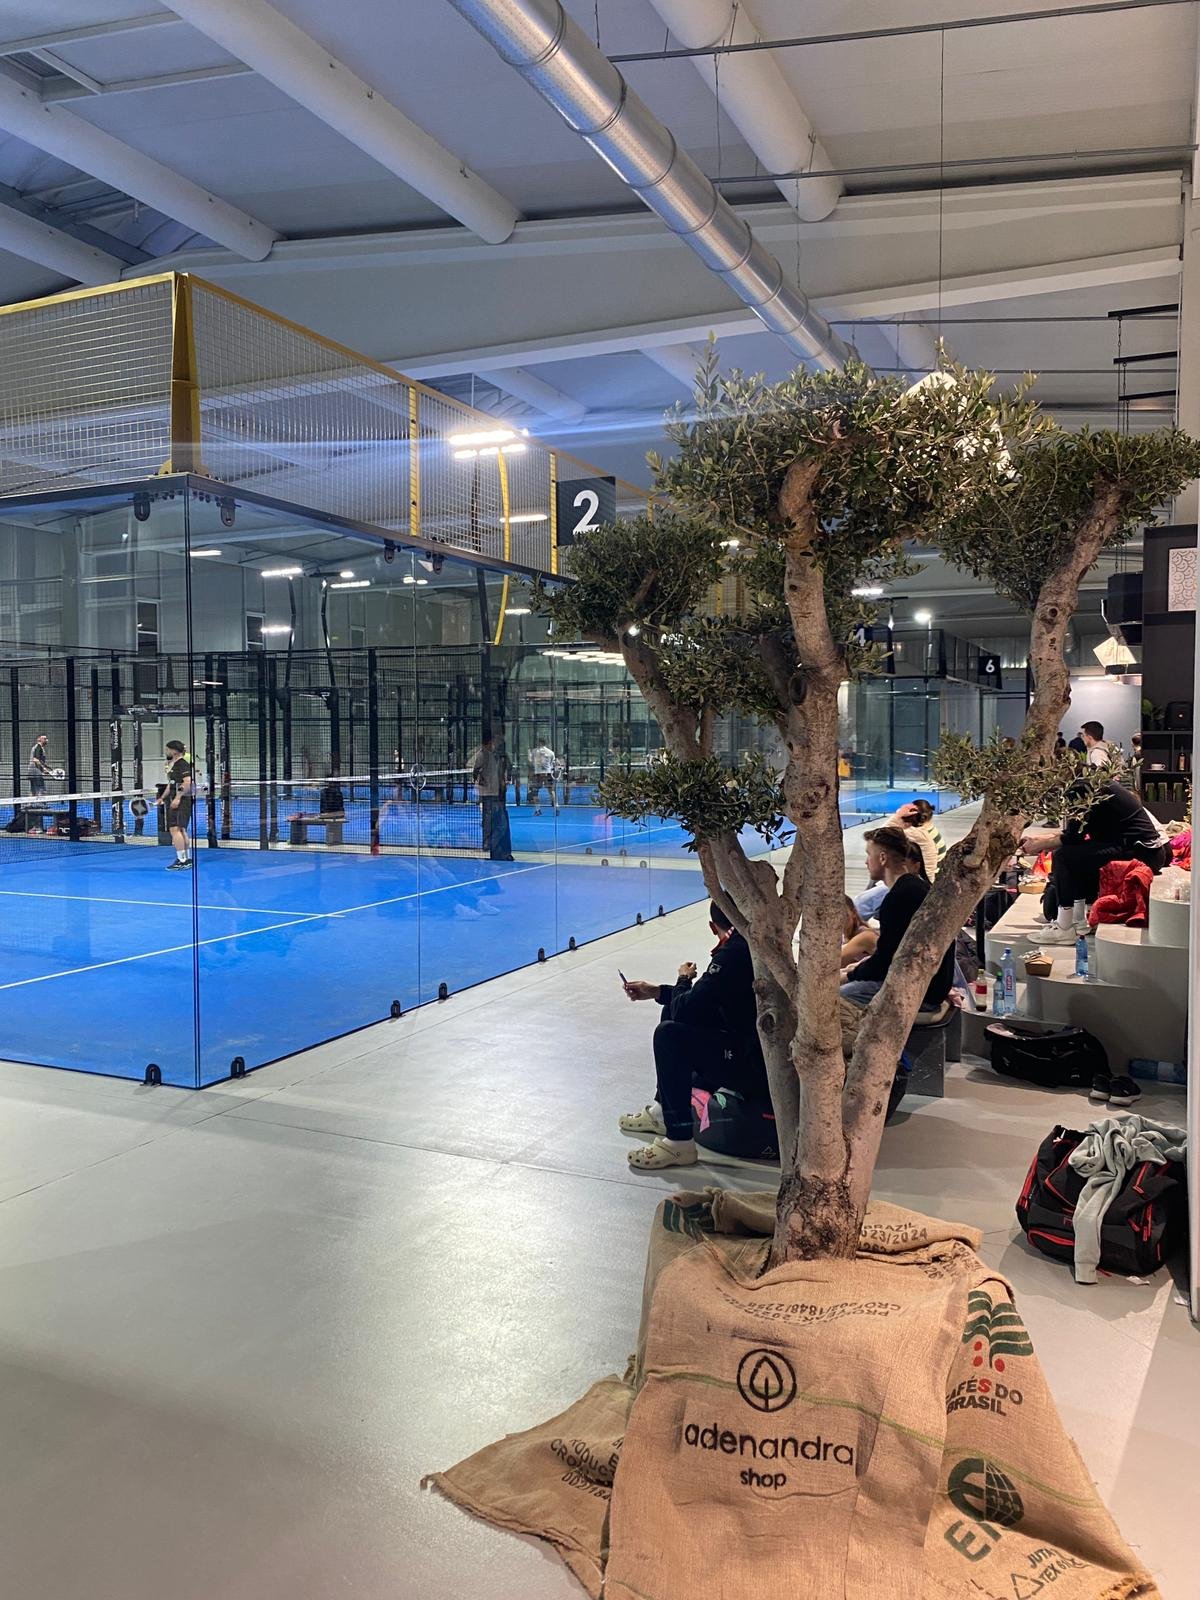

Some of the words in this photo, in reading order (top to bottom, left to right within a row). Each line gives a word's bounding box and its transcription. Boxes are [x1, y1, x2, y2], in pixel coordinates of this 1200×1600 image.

[573, 489, 600, 535] 2
[985, 659, 995, 673] 6
[995, 1383, 1023, 1405] DO
[684, 1422, 853, 1466] adenandra
[740, 1468, 787, 1490] shop
